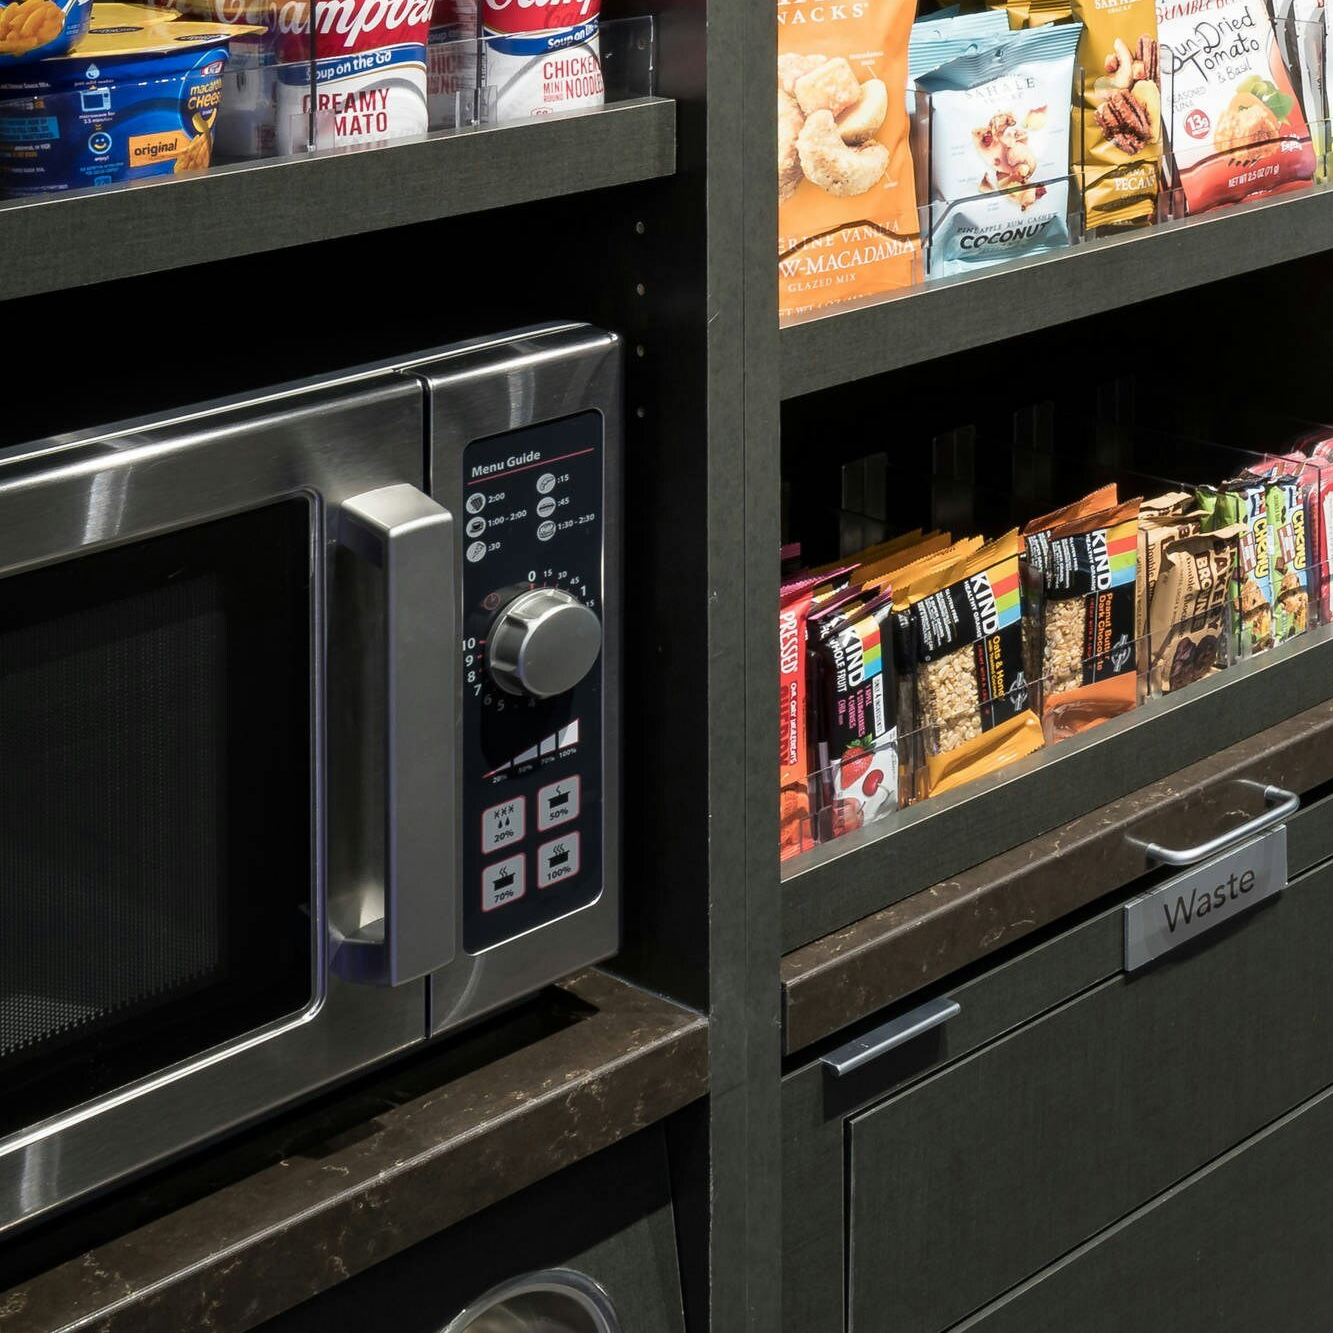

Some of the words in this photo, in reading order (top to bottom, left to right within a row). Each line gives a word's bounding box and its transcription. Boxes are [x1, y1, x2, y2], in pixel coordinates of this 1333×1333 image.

[549, 36, 573, 50] Soup
[575, 30, 585, 42] on
[337, 62, 351, 75] on
[353, 54, 373, 71] the
[376, 50, 392, 64] Go
[1182, 37, 1261, 83] Tomato
[1226, 59, 1252, 80] Basil
[543, 83, 563, 95] MINI
[134, 139, 178, 157] original
[960, 222, 1047, 249] COCONUT
[787, 276, 833, 294] GLAZED
[836, 272, 856, 287] MIX
[471, 461, 505, 478] Menu
[506, 450, 541, 467] Guide
[488, 492, 506, 504] 2:00
[487, 516, 505, 528] 1:00
[510, 509, 528, 521] 2:00
[557, 520, 574, 531] 1:30
[578, 513, 596, 525] 2:30
[1085, 533, 1094, 562] HEALTHY
[1091, 529, 1112, 591] KIND
[528, 570, 537, 583] 0
[557, 571, 568, 580] 30
[964, 581, 976, 611] HEALTHY
[971, 611, 982, 638] GRAINS
[970, 570, 999, 635] KIND
[1098, 593, 1106, 617] Dark
[1105, 592, 1114, 625] Peanut
[462, 637, 476, 651] 10
[779, 609, 798, 675] PRESSED
[992, 635, 1002, 655] Oats
[465, 655, 474, 668] 9
[839, 628, 864, 688] KIND
[467, 671, 476, 683] 8
[837, 672, 848, 693] FRUIT
[473, 684, 482, 697] 7
[549, 806, 569, 821] 50%
[494, 829, 514, 843] 20%
[547, 865, 572, 881] 100%
[494, 888, 514, 904] 70%
[1163, 870, 1256, 933] Waste
